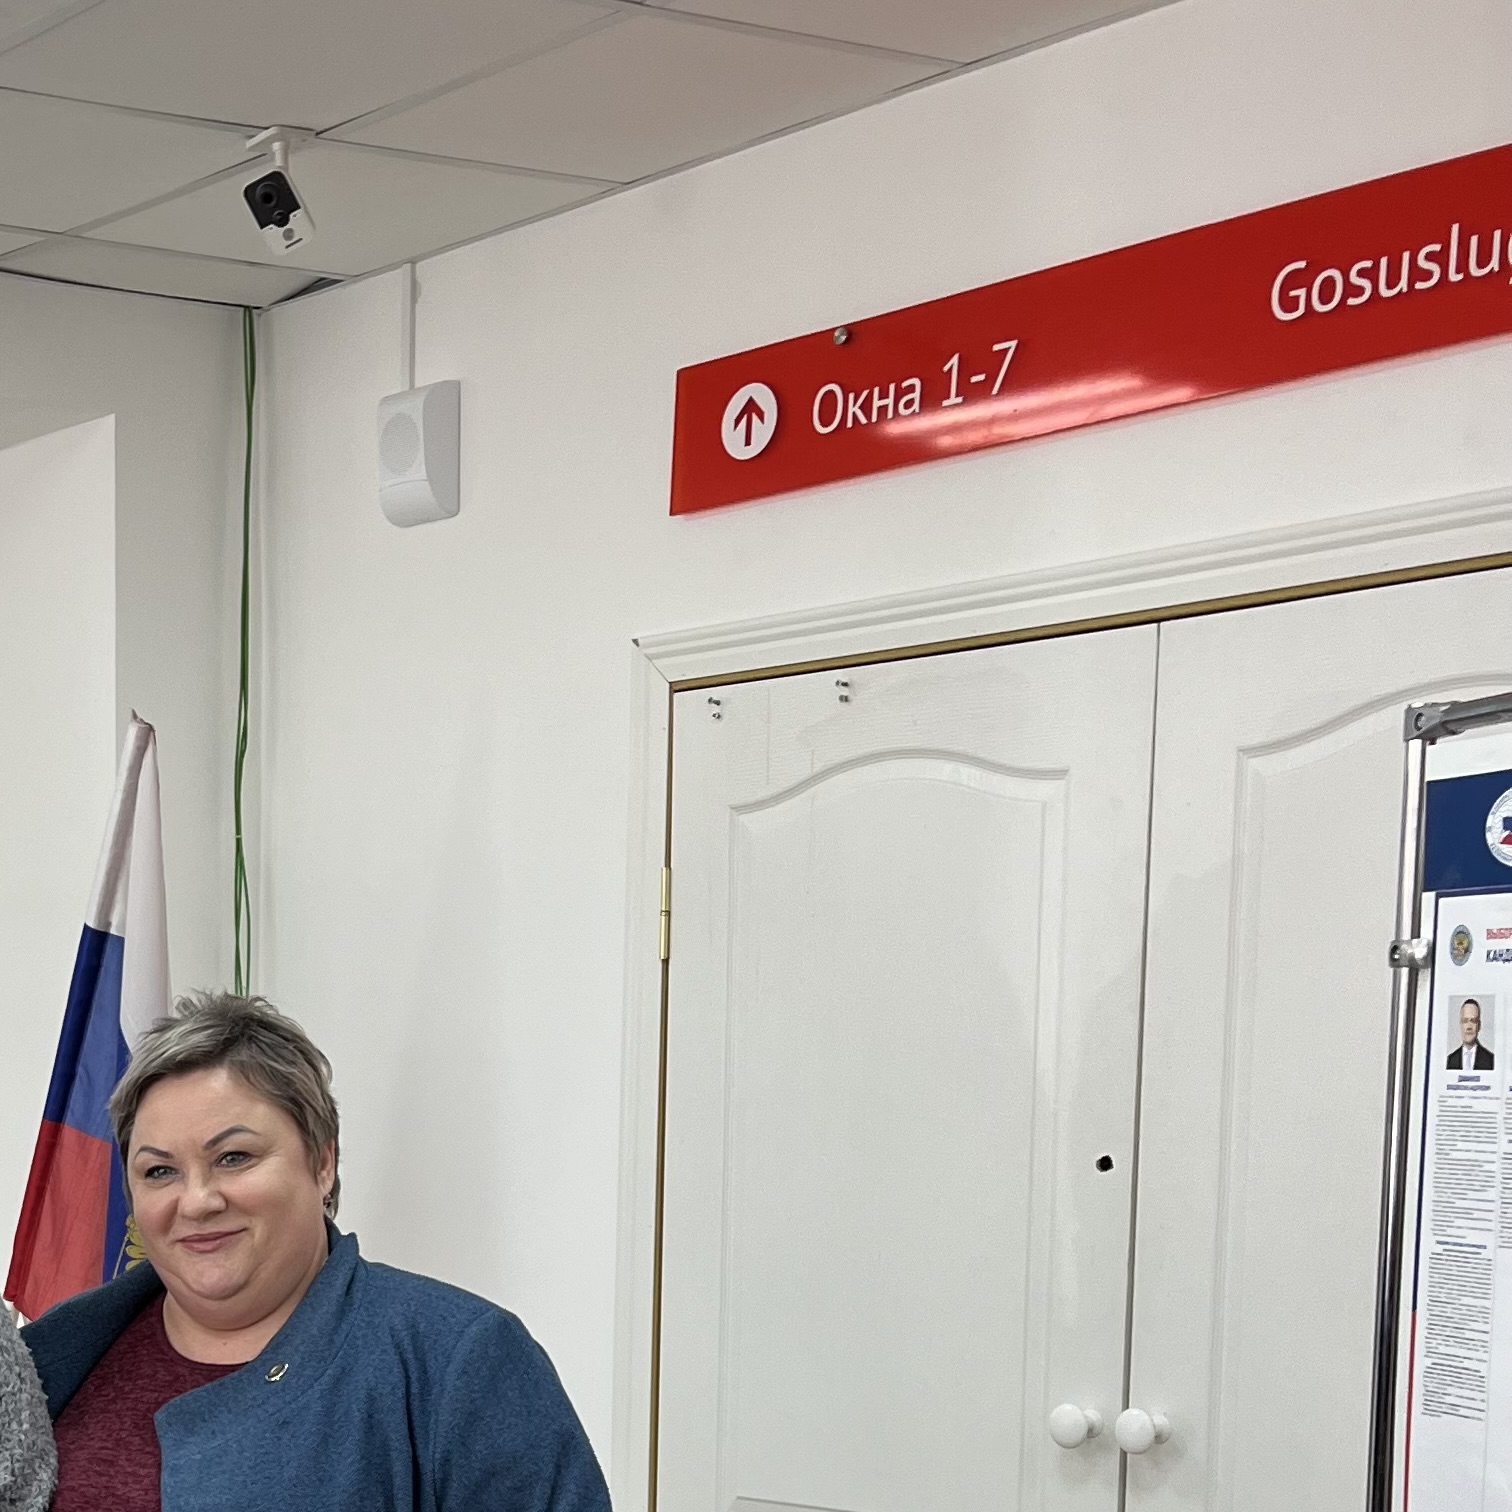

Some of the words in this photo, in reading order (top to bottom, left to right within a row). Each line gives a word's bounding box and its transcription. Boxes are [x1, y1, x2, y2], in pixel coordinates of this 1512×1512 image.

[1271, 222, 1512, 321] Gosuslu
[812, 377, 922, 434] Окна
[941, 339, 1019, 407] 1-7
